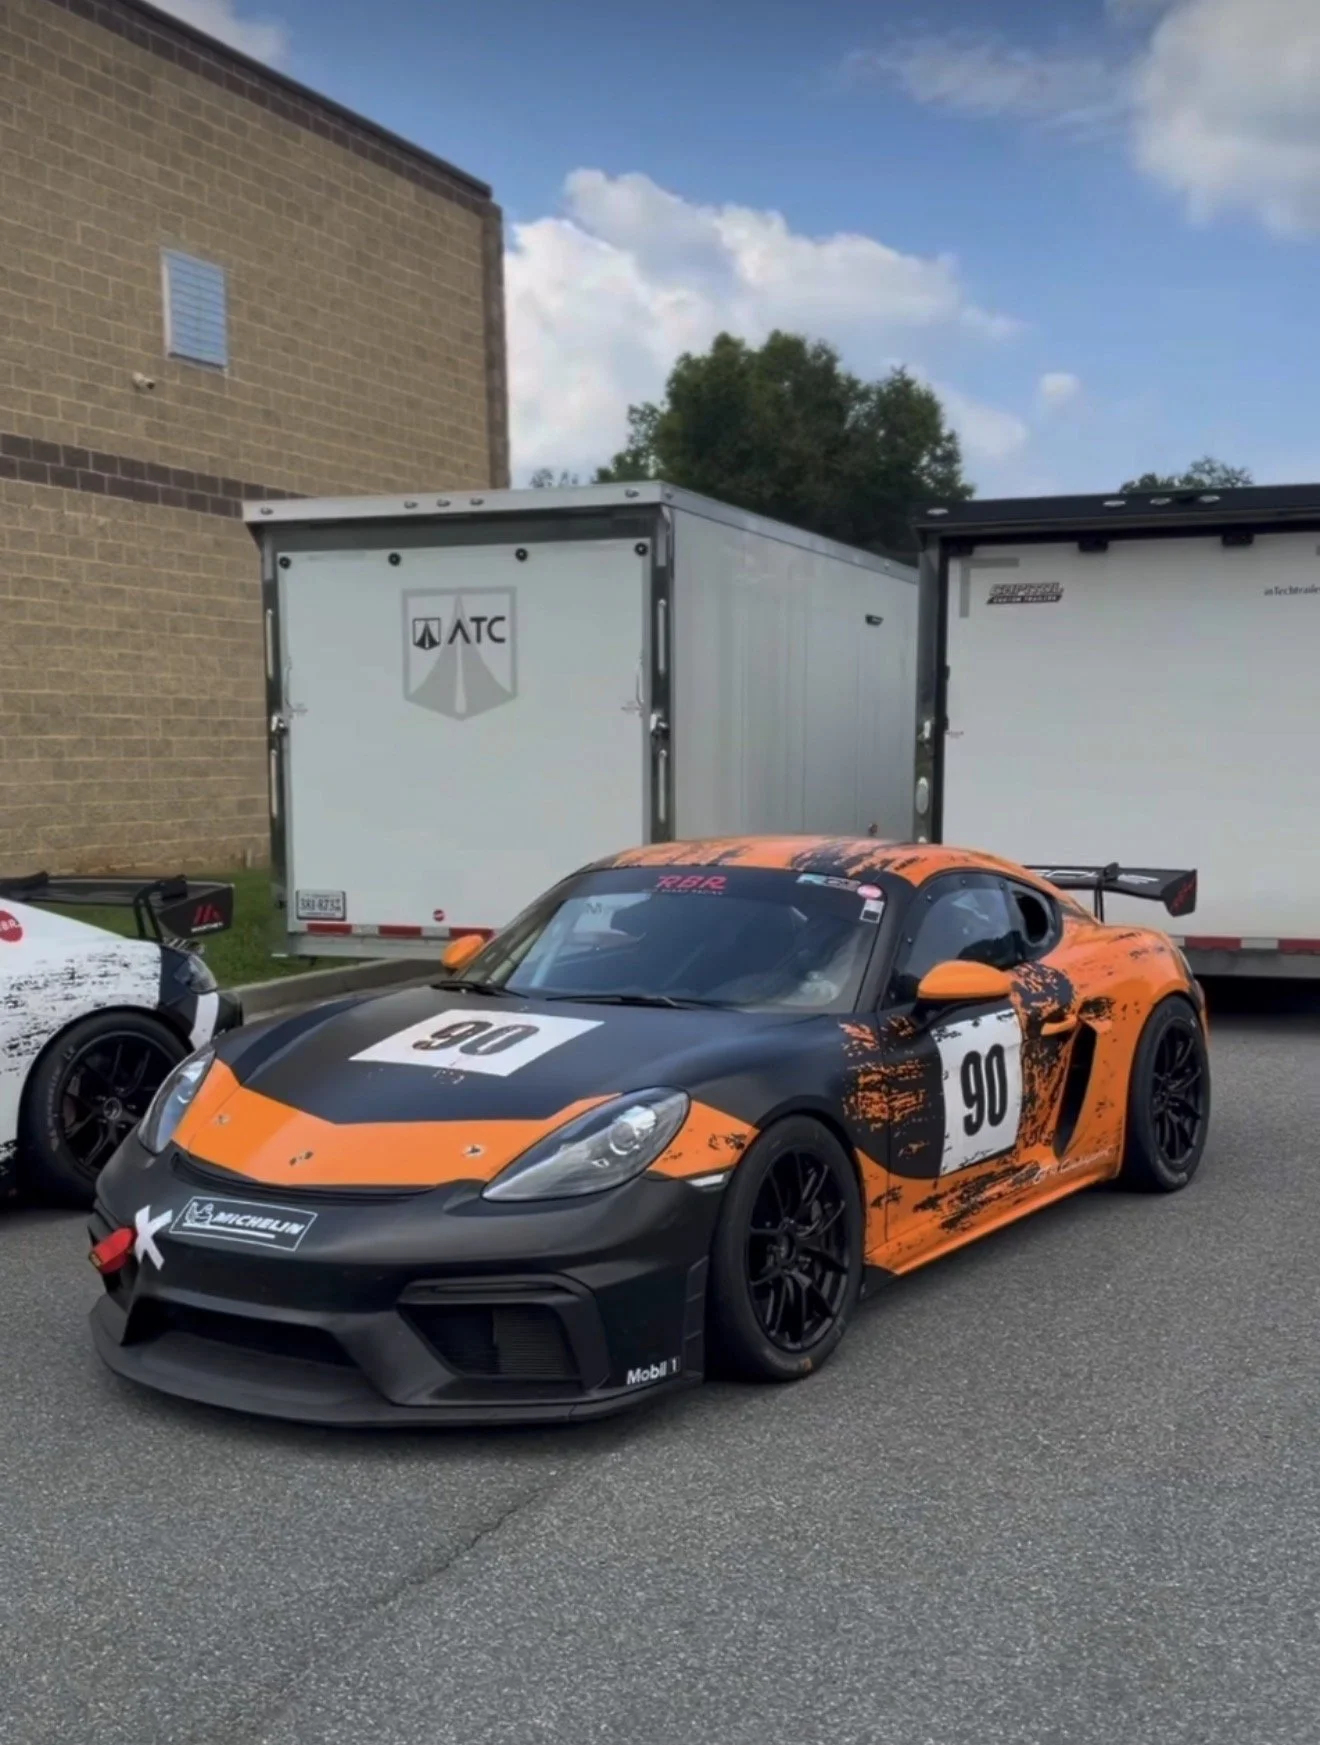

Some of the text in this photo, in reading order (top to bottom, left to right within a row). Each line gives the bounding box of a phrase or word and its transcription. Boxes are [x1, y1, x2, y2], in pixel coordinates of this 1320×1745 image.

[447, 615, 506, 645] ATC
[654, 875, 728, 890] RBR
[412, 1020, 540, 1056] 90
[960, 1043, 1008, 1137] 90
[212, 1211, 305, 1235] MICHELIN
[626, 1360, 668, 1385] Mobil
